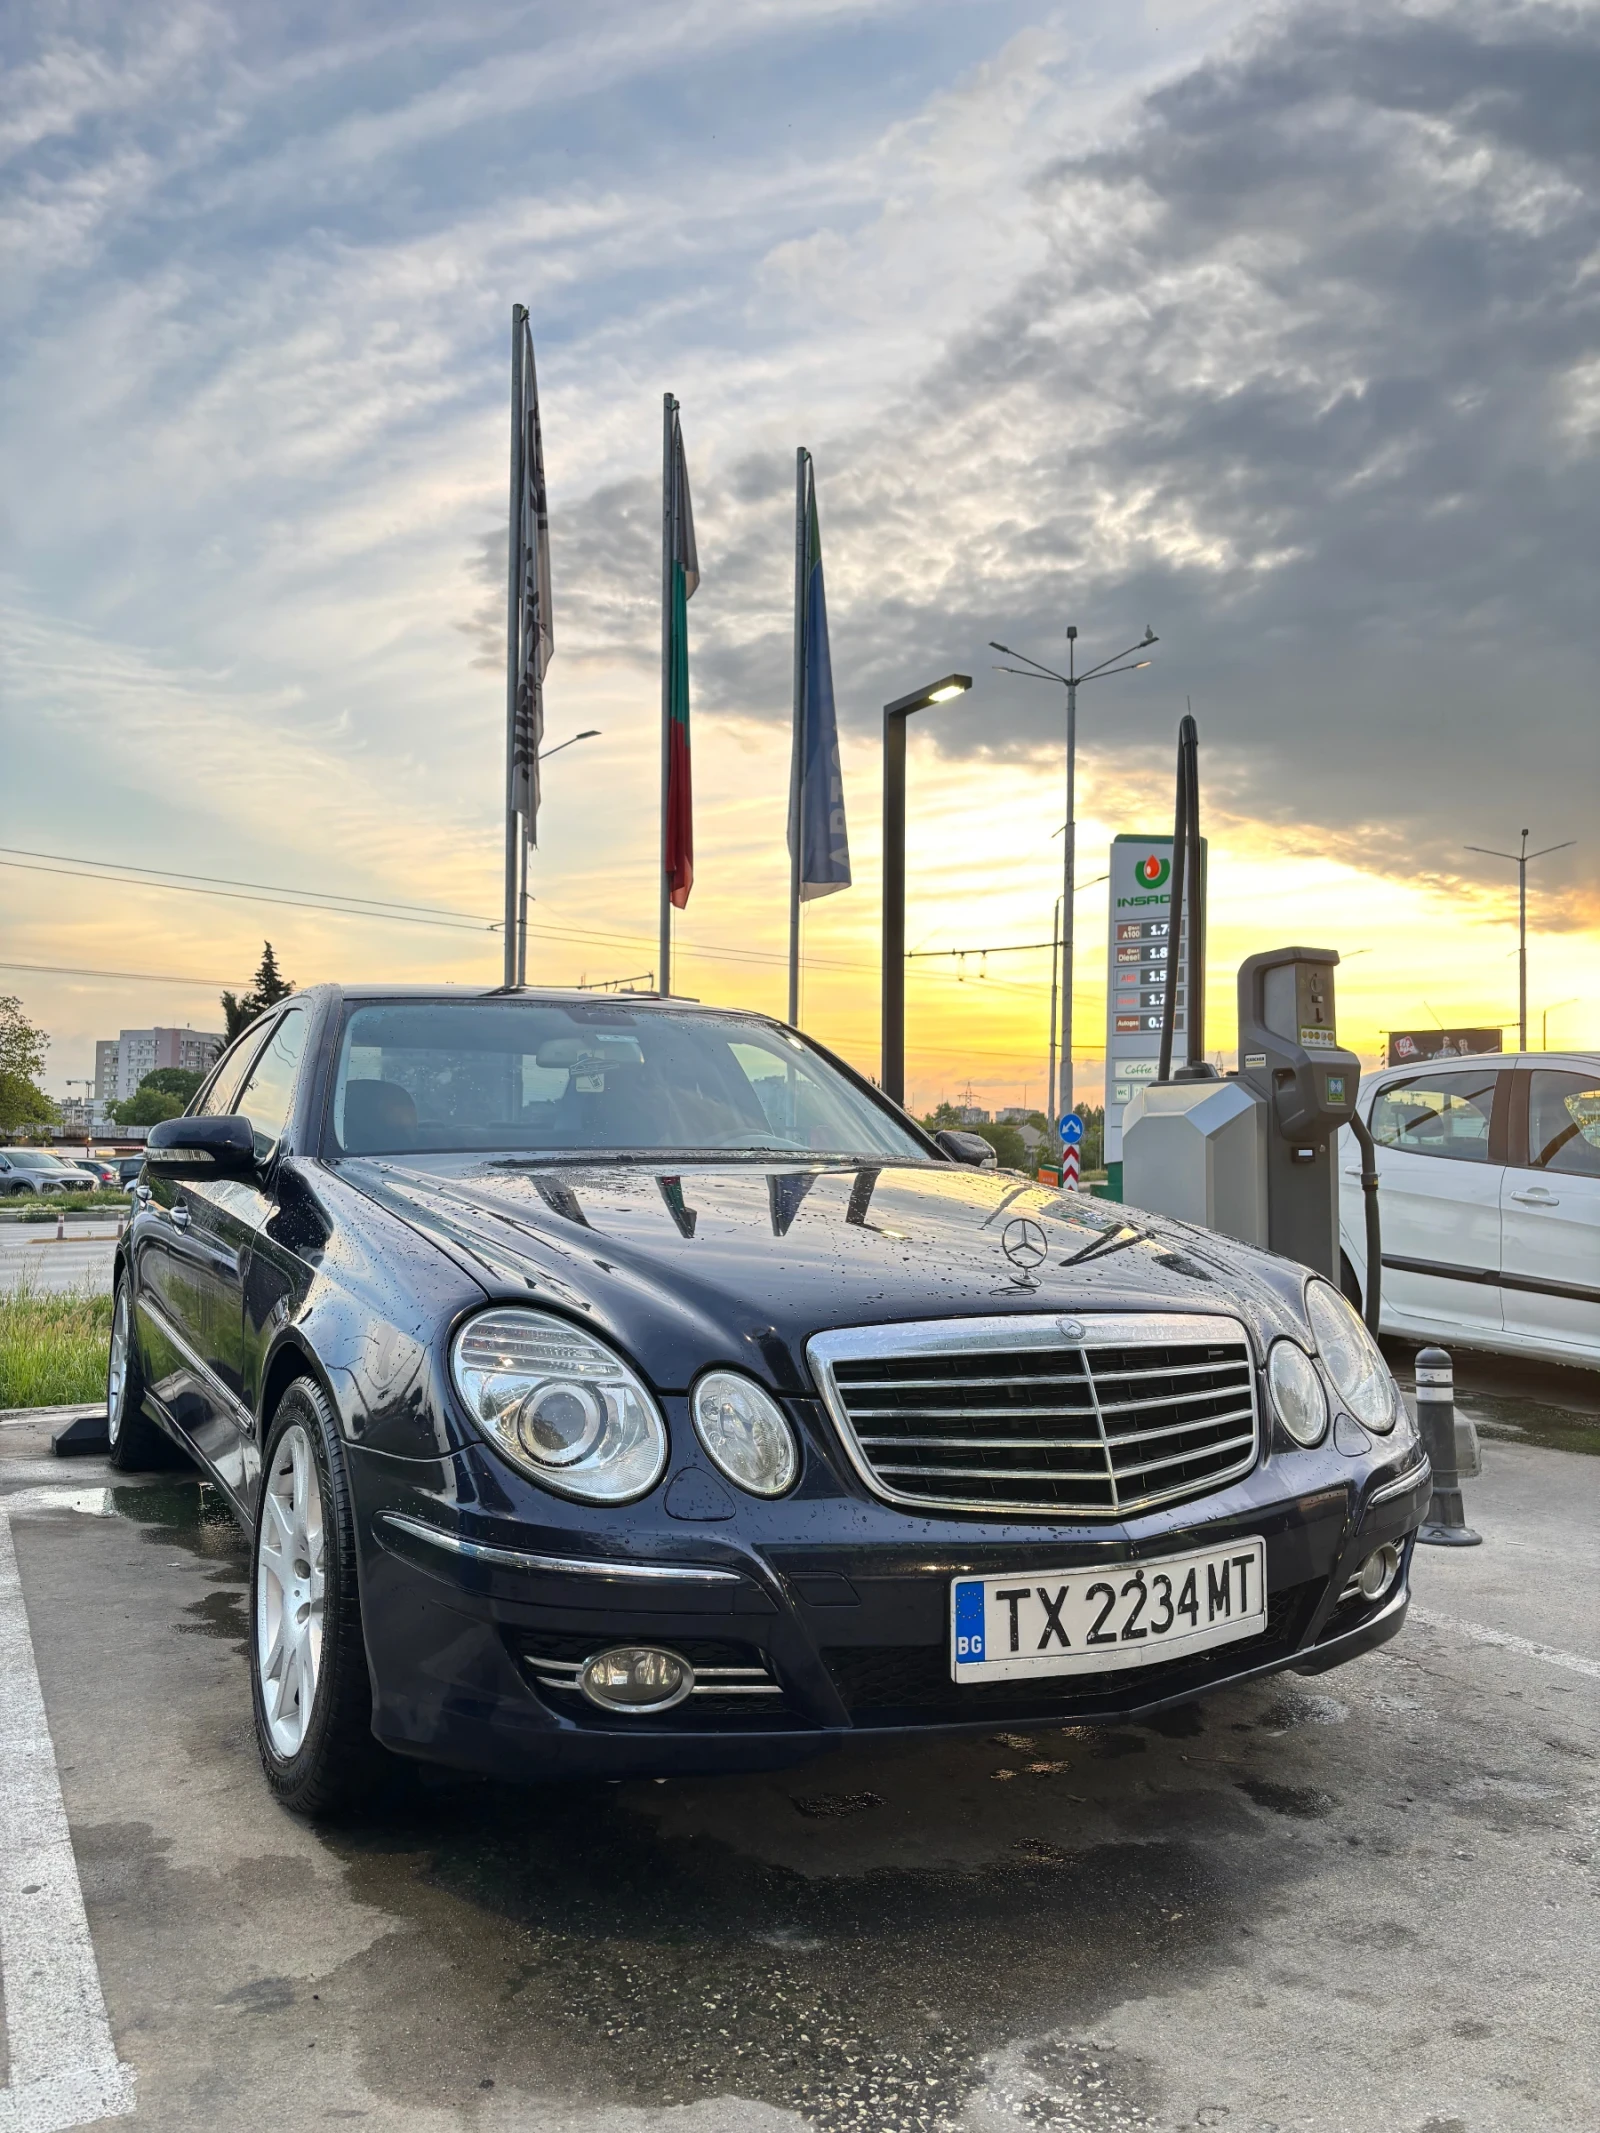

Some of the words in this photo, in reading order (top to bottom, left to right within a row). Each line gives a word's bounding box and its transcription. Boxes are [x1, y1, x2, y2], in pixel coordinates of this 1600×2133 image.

[1117, 894, 1186, 908] INSAO
[1122, 931, 1140, 939] A100
[1150, 924, 1170, 936] 1.7
[1118, 954, 1140, 962] Diesel
[1149, 947, 1168, 959] 1.8
[1149, 970, 1167, 982] 1.5
[1149, 994, 1166, 1006] 1.7
[1117, 1019, 1139, 1028] Autogas
[1125, 1064, 1152, 1074] Coffee
[996, 1585, 1071, 1652] TX
[1085, 1568, 1199, 1644] 2234
[1207, 1554, 1255, 1622] MT
[957, 1635, 983, 1655] BG
